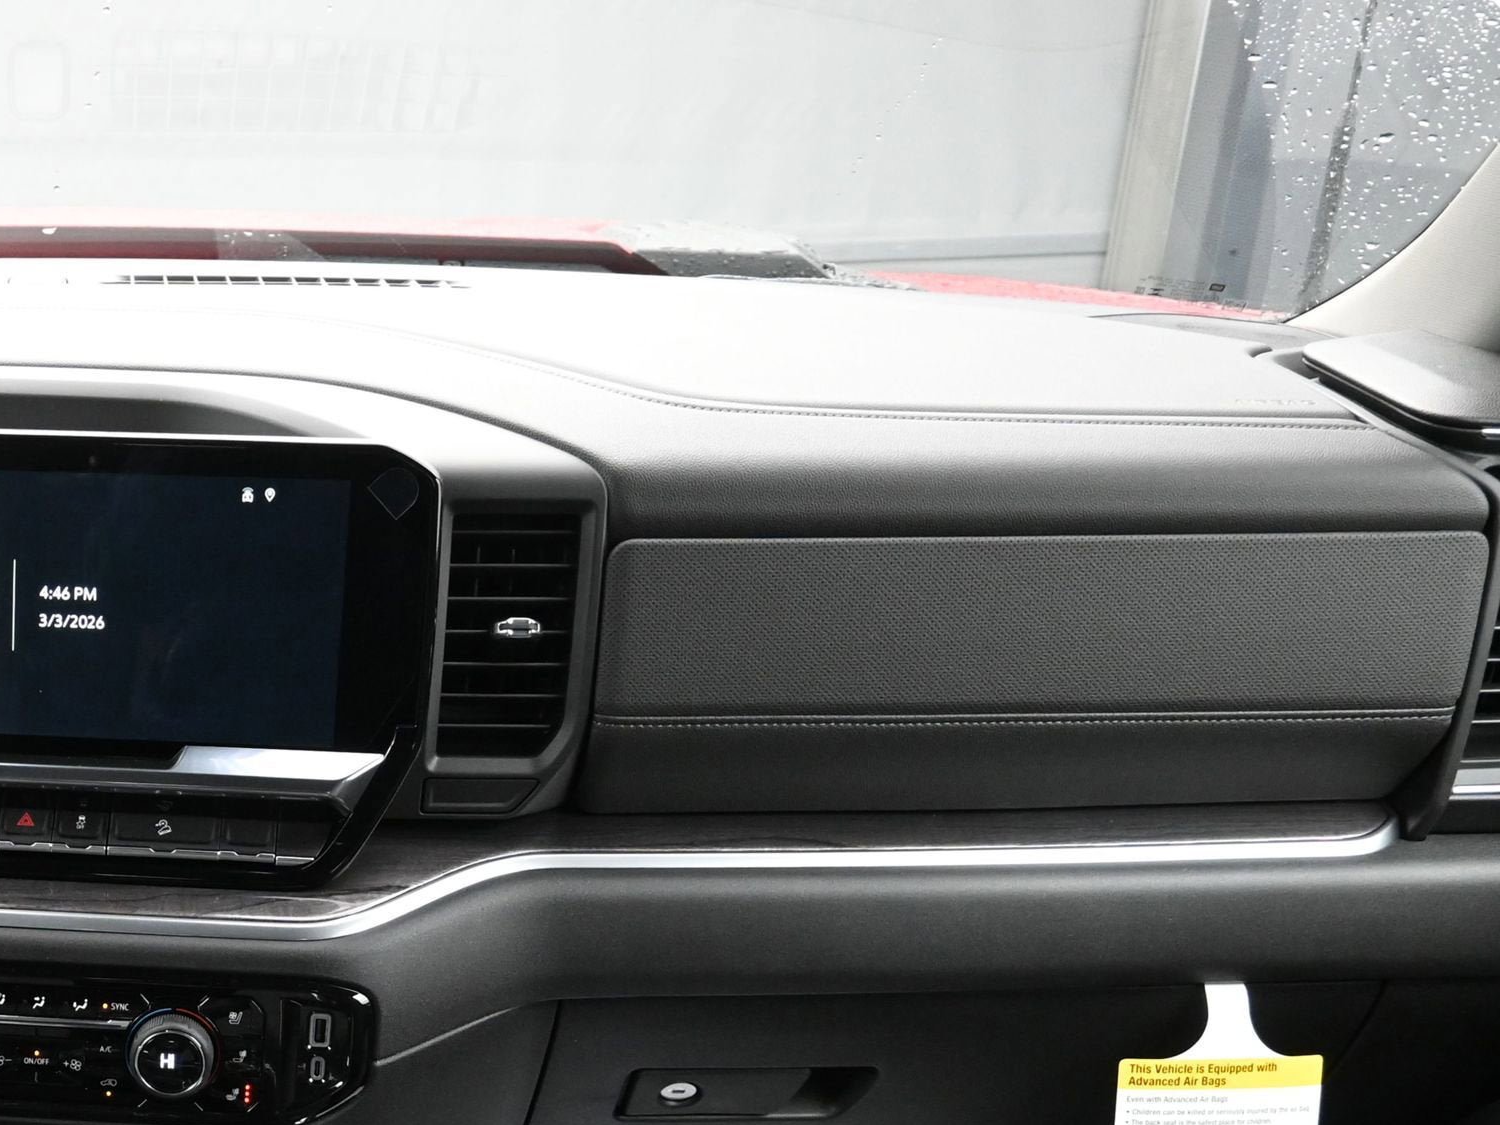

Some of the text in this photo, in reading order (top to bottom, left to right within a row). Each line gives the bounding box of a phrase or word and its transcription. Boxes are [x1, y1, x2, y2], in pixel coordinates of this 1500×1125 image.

[39, 585, 98, 601] 4:46 PM
[38, 613, 105, 630] 3/3/2026
[110, 1003, 129, 1011] SYNC
[100, 1045, 112, 1053] A/C
[23, 1057, 50, 1065] ON/OFF
[160, 1053, 175, 1069] HI
[1129, 1062, 1277, 1075] This Vehicle is Equipped with
[1128, 1076, 1227, 1087] Advanced Air Bags
